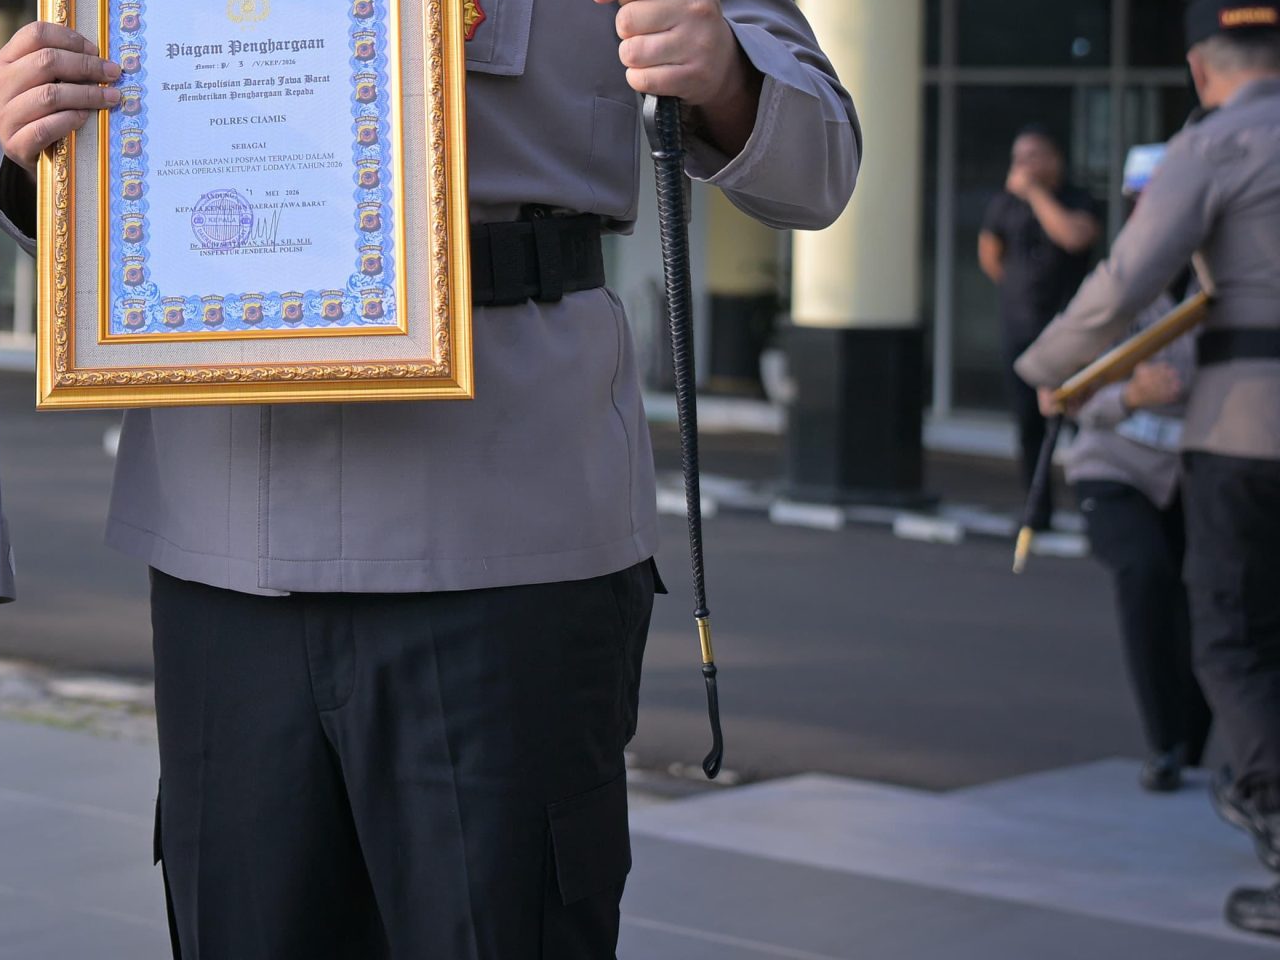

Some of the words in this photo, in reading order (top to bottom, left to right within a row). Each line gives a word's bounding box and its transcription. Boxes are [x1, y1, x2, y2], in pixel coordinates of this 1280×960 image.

[165, 42, 223, 60] Piagam
[228, 38, 325, 56] Penghargaan
[161, 82, 192, 91] Kepala
[194, 80, 241, 90] Kepolisian
[242, 77, 276, 86] Daerah
[278, 76, 302, 86] Jawa
[304, 74, 330, 83] Barat
[178, 92, 228, 102] Memberikan
[229, 90, 283, 100] Penghargaan
[284, 88, 314, 97] Kepada
[209, 116, 248, 126] POLRES
[250, 114, 287, 124] CIAMIS
[231, 142, 266, 150] SEBAGAI
[192, 158, 229, 166] HARAPAN
[234, 156, 266, 164] POSPAM
[268, 154, 304, 162] TERPADU
[305, 152, 334, 160] DALAM
[157, 168, 190, 176] RANGKA
[192, 166, 224, 174] OPERASI
[263, 163, 296, 171] LODAYA
[297, 162, 326, 170] TAHUN
[326, 160, 343, 168] 2026
[249, 202, 279, 210] DAERAH
[302, 200, 327, 208] BARAT
[200, 248, 240, 256] INSPEKTUR
